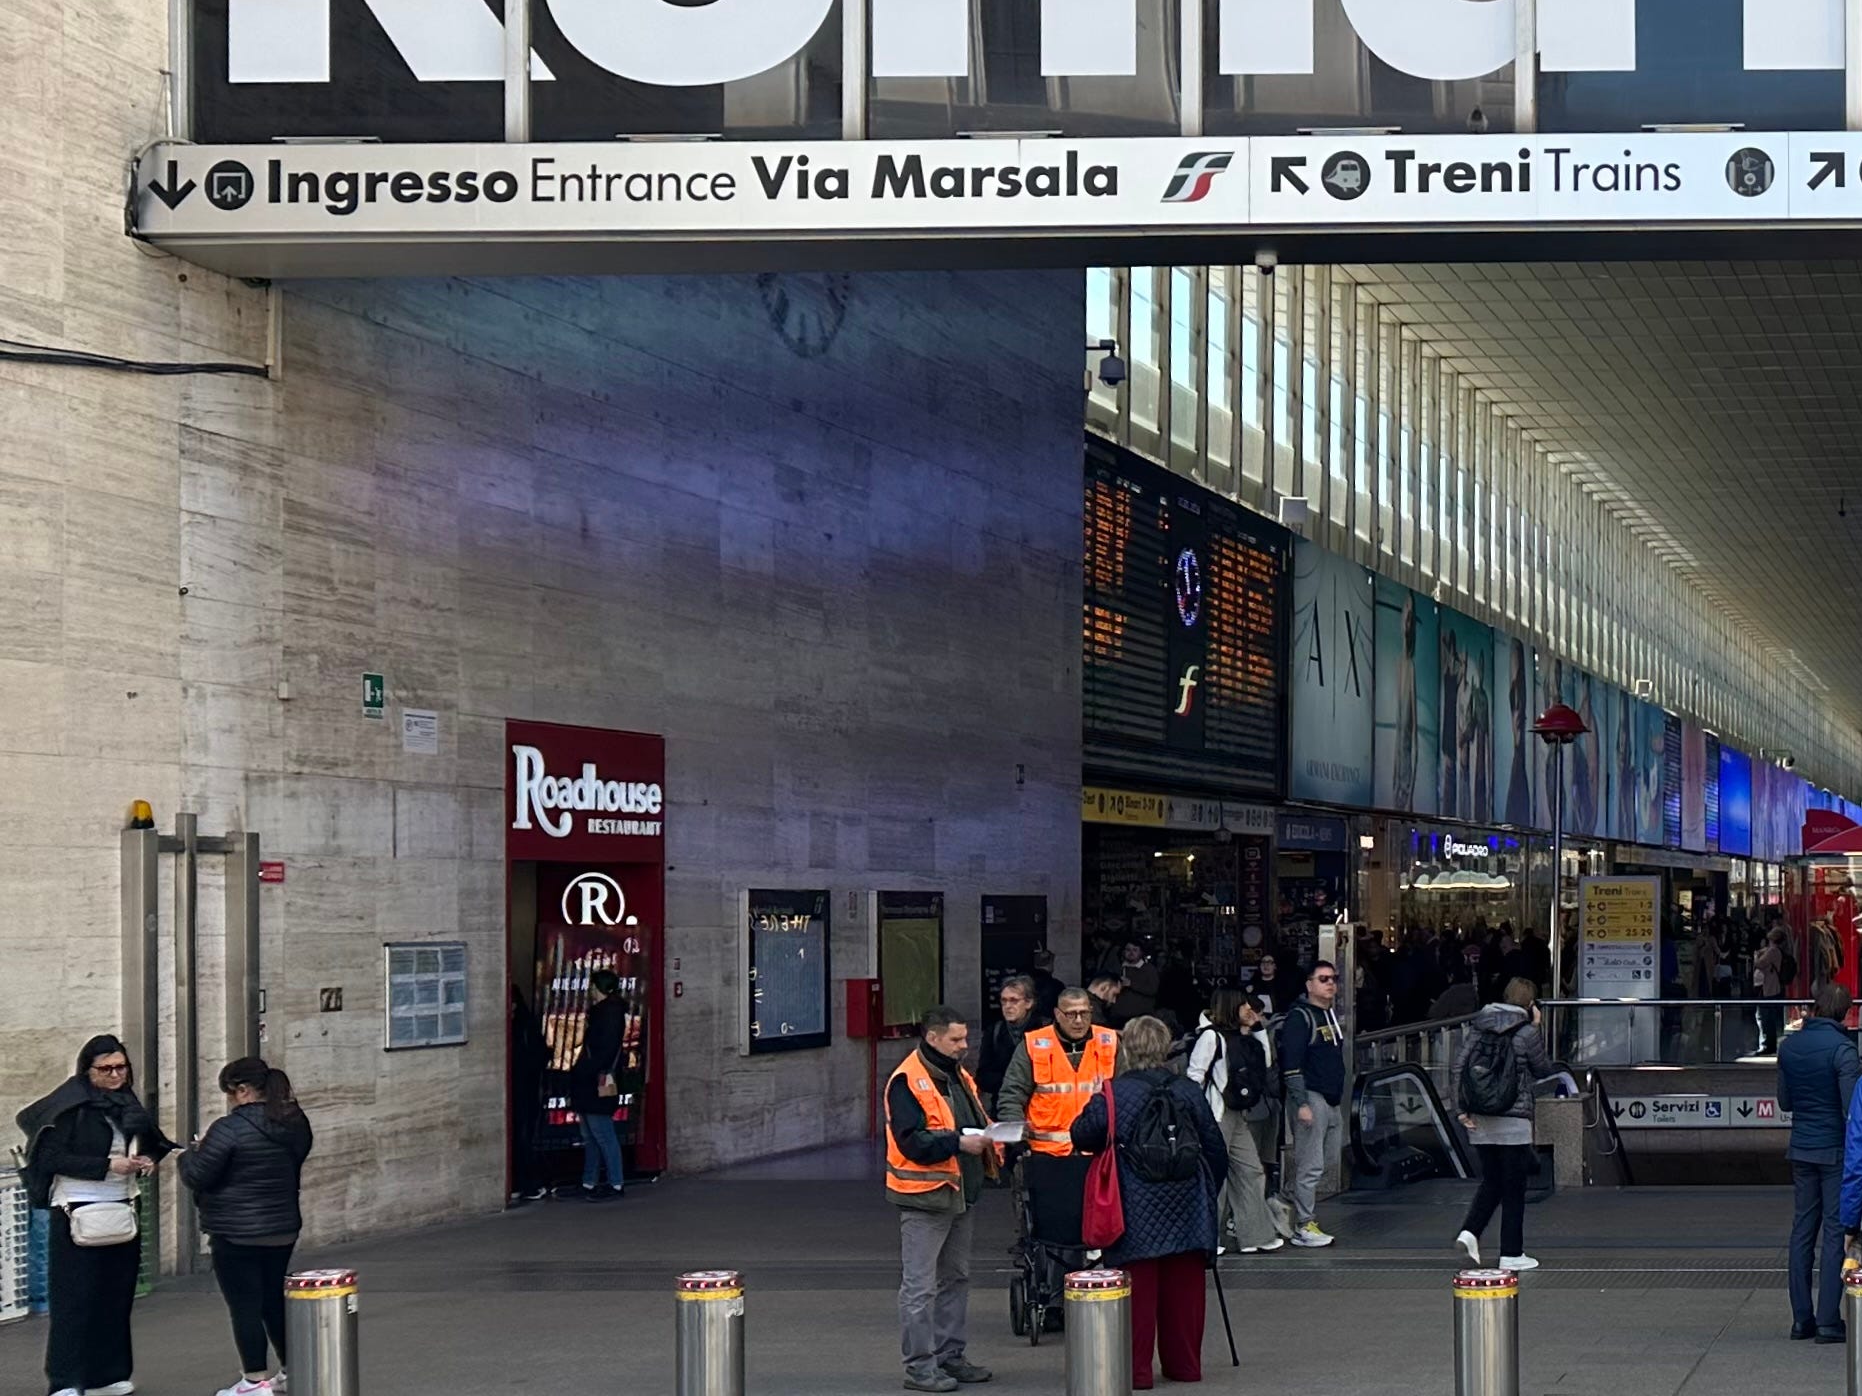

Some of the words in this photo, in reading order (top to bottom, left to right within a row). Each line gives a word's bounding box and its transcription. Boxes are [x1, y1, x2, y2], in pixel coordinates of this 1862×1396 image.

[266, 158, 519, 216] Ingresso
[530, 157, 736, 202] Entrance
[750, 154, 849, 200] Via
[870, 150, 1118, 199] Marsala
[1385, 147, 1531, 194] Treni
[1543, 147, 1682, 193] Trains
[512, 744, 662, 837] Roadhouse
[587, 818, 662, 836] RESTAURANT
[1592, 885, 1622, 896] Treni
[1652, 1100, 1699, 1113] Servizi
